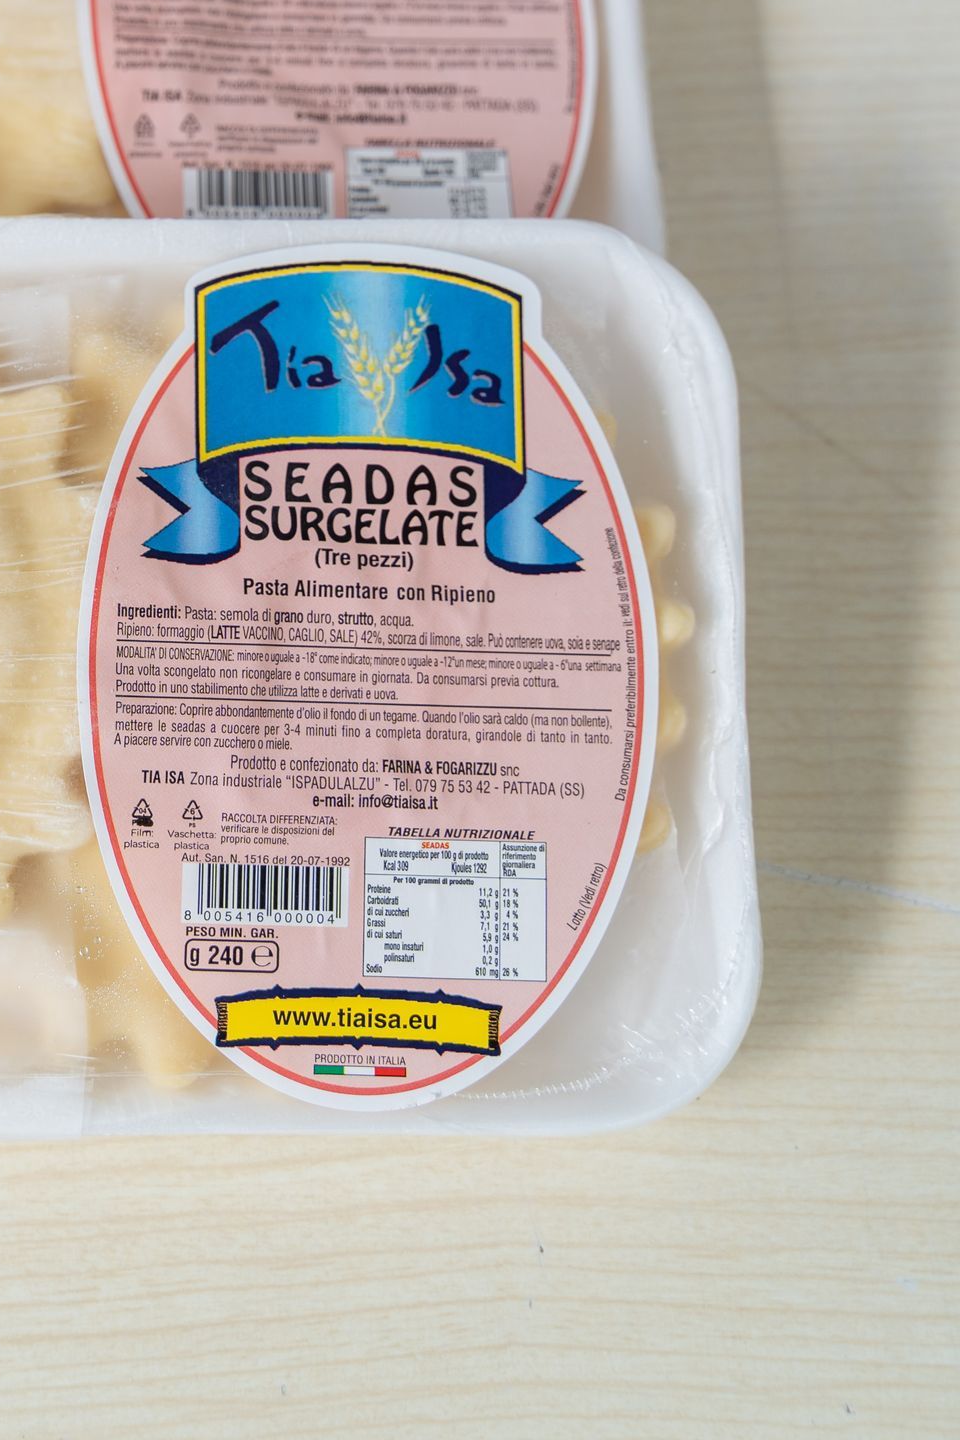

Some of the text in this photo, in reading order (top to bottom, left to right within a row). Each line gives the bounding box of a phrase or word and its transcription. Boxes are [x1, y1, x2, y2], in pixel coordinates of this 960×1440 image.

[209, 300, 342, 393] Tia
[244, 460, 478, 507] SEADAS
[244, 504, 479, 548] SURGELATE
[315, 548, 414, 572] (Tre pezzi)
[243, 577, 495, 606] Pasta Alimentare con Ripieno
[117, 602, 414, 629] Ingredienti: Pasta: semola di grano duro, strutto, acqua.
[623, 629, 636, 654] entro
[115, 663, 559, 688] Una volta scongelato non ricongelare e consumare in giornata. Da consumarsi previa cottura.
[624, 656, 637, 728] preferibilmente
[113, 733, 292, 750] A piacere servire con zucchero o miele.
[114, 720, 612, 744] mettere le seadas a cuocere per 3-4 minuti fino a completa doratura, girandole di tanto in tanto.
[230, 754, 519, 777] Prodotto e confezionato da: FARINA & FOGARIZZU snc
[618, 729, 634, 783] consumarsi
[141, 769, 161, 784] TIA
[164, 769, 185, 785] ISA
[189, 771, 219, 786] Zona
[222, 772, 282, 789] industriale
[392, 777, 412, 792] Tel.
[415, 778, 437, 793] 079
[440, 778, 455, 793] 75
[458, 779, 473, 794] 53
[475, 779, 491, 794] 42
[502, 780, 556, 796] PATTADA
[559, 782, 584, 800] (SS)
[614, 785, 627, 802] Da
[312, 793, 438, 810] e-mail: info@tiaisa.it
[220, 825, 335, 837] verificare le disposizioni del
[221, 813, 338, 826] RACCOLTA DIFFERENZIATA:
[131, 828, 217, 840] Film: Vaschetta:
[220, 835, 289, 846] proprio comune.
[388, 826, 535, 841] TABELLA NUTRIZIONALE
[123, 839, 210, 852] plastica plastica
[182, 853, 351, 867] Aut. San. N. 1516 del 20-07-1992
[567, 903, 586, 932] Lotto
[589, 862, 608, 886] retro)
[185, 926, 278, 939] PESO MIN. GAR.
[189, 944, 244, 967] g 240
[272, 1007, 436, 1030] www.tiaisa.eu
[313, 1053, 406, 1066] PRODOTTO IN ITALIA
